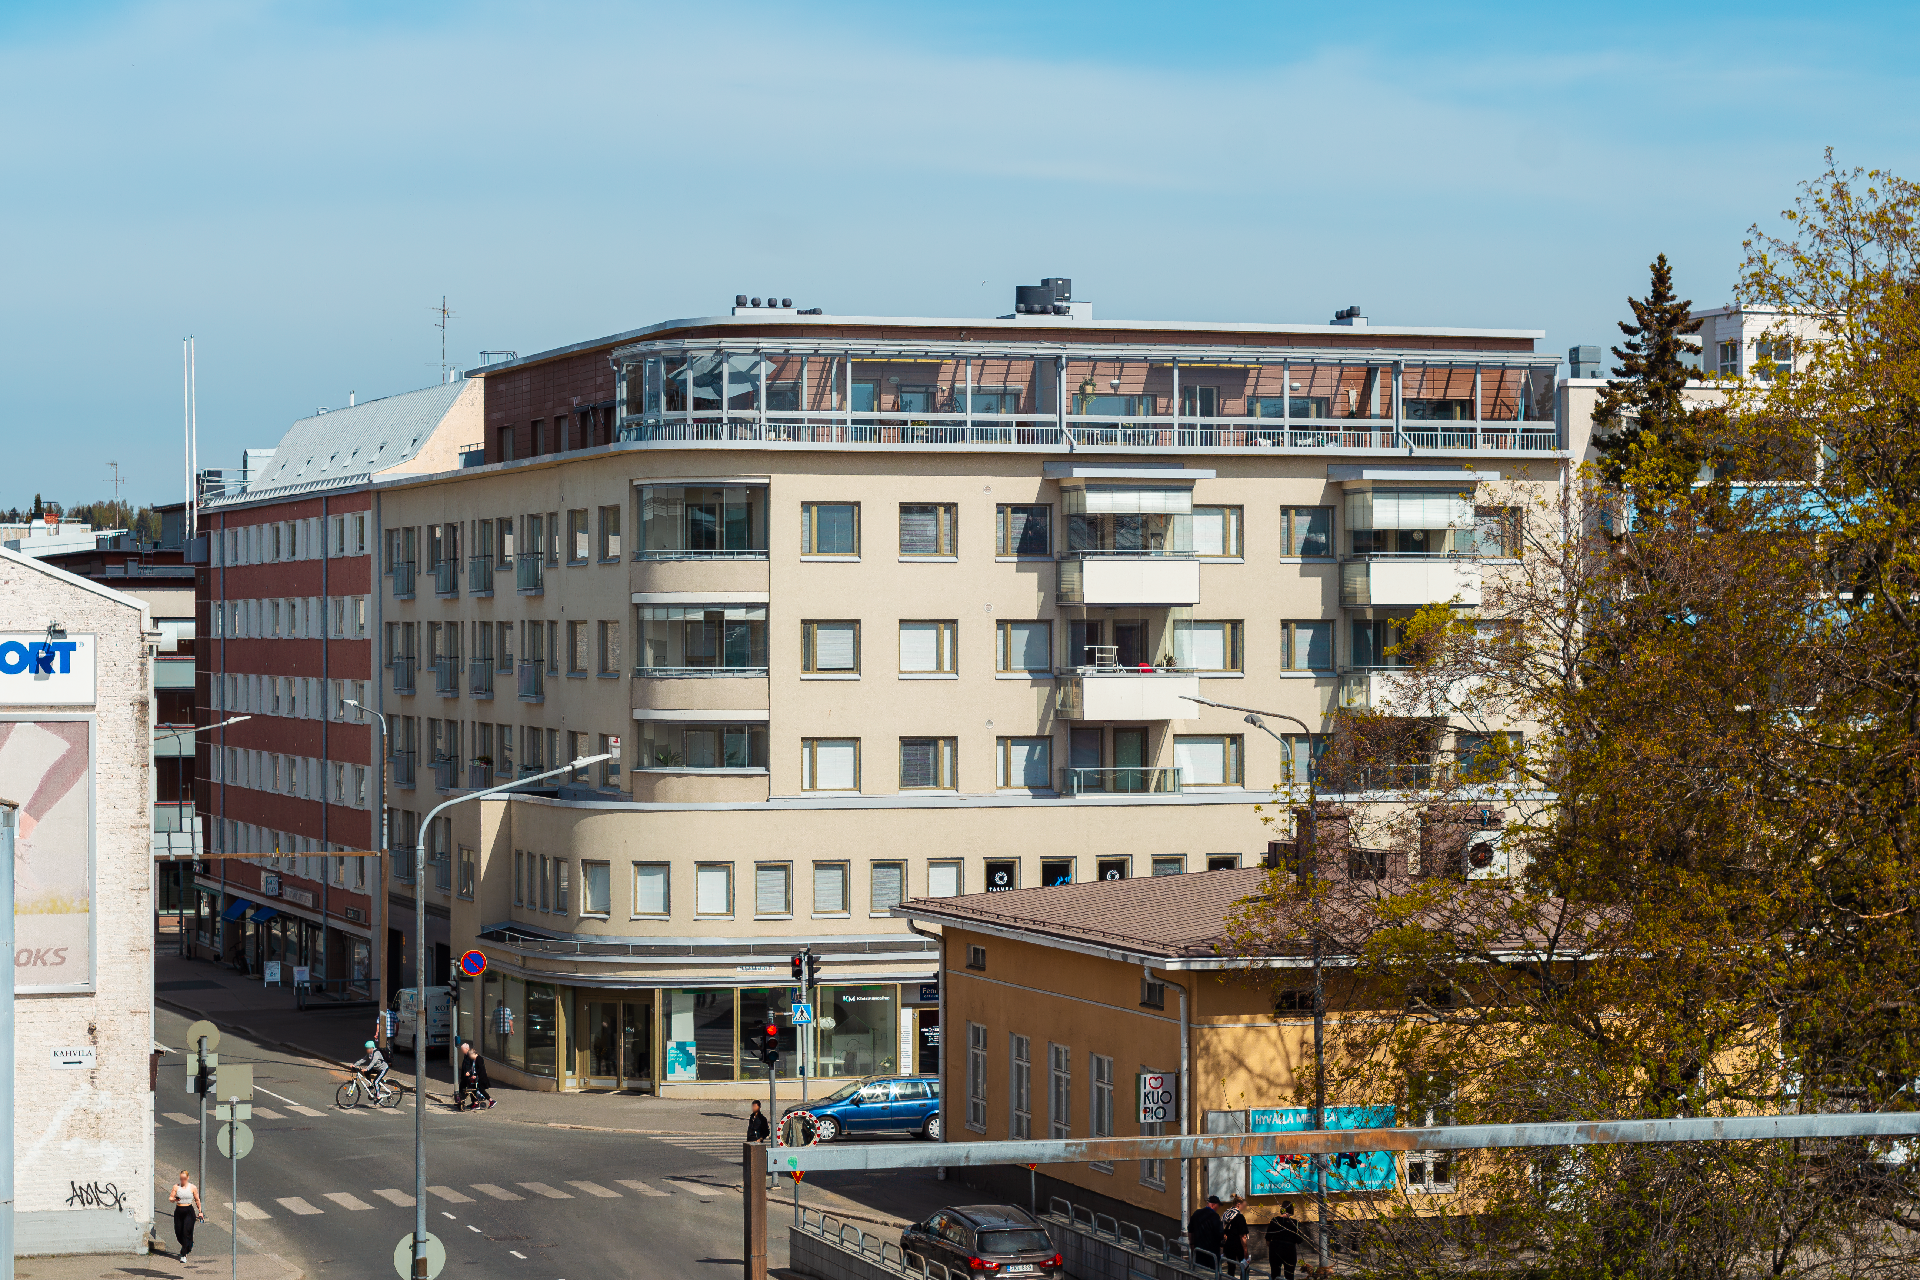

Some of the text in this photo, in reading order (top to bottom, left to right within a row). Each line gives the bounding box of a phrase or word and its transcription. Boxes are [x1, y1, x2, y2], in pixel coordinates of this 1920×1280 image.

[14, 947, 68, 967] OKS
[1143, 1076, 1147, 1090] I
[1143, 1090, 1173, 1105] KUO
[1142, 1106, 1167, 1120] PIO
